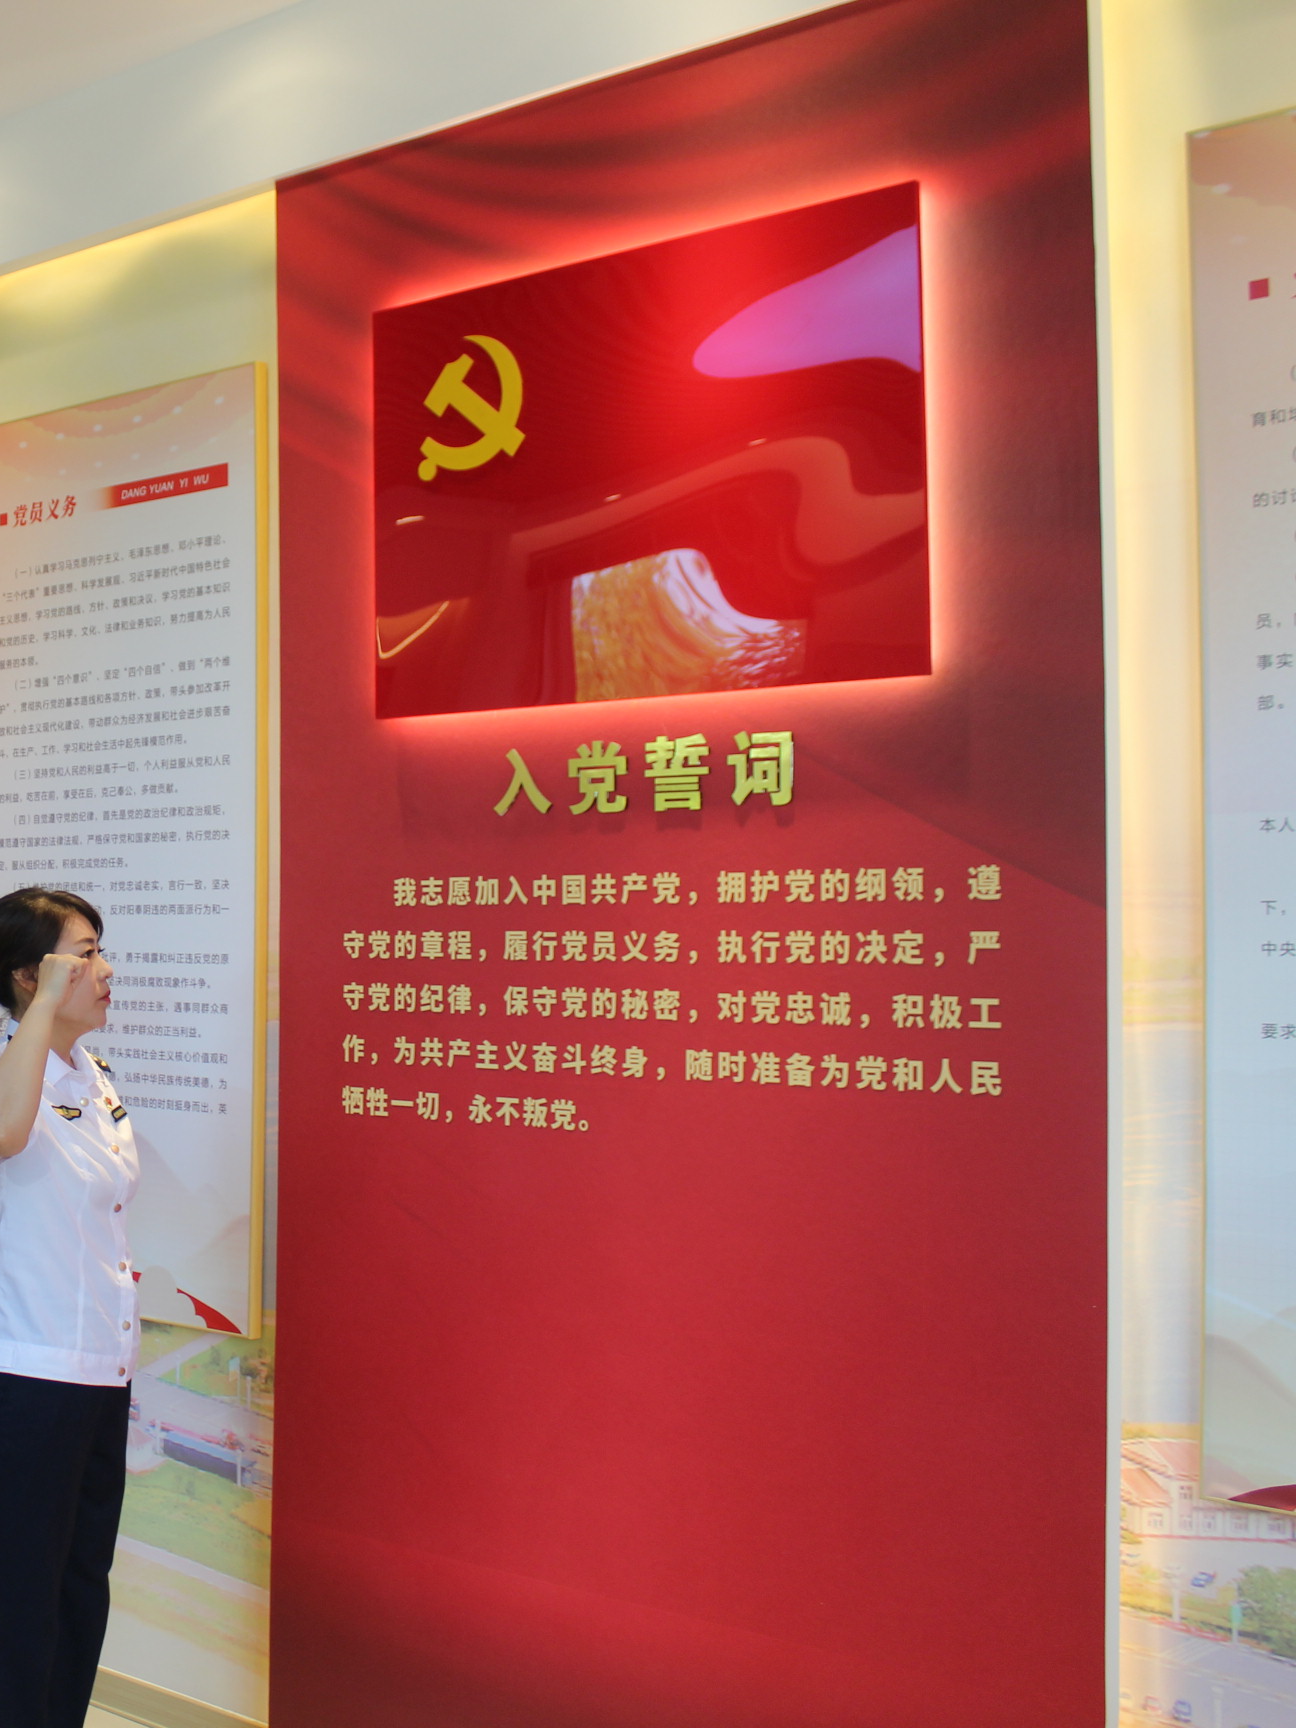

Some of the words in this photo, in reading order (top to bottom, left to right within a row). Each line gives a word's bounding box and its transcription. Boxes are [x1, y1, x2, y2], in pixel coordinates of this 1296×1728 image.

[121, 487, 147, 500] DANG
[149, 481, 174, 496] YUAN
[179, 478, 189, 488] YI
[193, 474, 210, 486] WU
[13, 495, 77, 527] 党员义务
[1257, 653, 1293, 671] 事实
[493, 730, 794, 817] 入党誓词
[1260, 817, 1295, 833] 本人
[393, 864, 1002, 907] 我志愿加入中国共产党，拥护党的纲领，遵
[343, 930, 1001, 966] 守党的章程，履行党员义务，执行党的决定，严
[1261, 941, 1296, 957] 中央
[109, 1001, 228, 1015] 宣传党的主张，遇事同群众商
[342, 982, 1002, 1030] 守党的纪律，保守党的秘密，对党忠诚，积极工
[1261, 1023, 1296, 1040] 要求
[342, 1034, 1002, 1096] 作，为共产主义奋斗终身，随时准备为党和人民
[342, 1086, 589, 1132] 牺牲一切，永不叛党。
